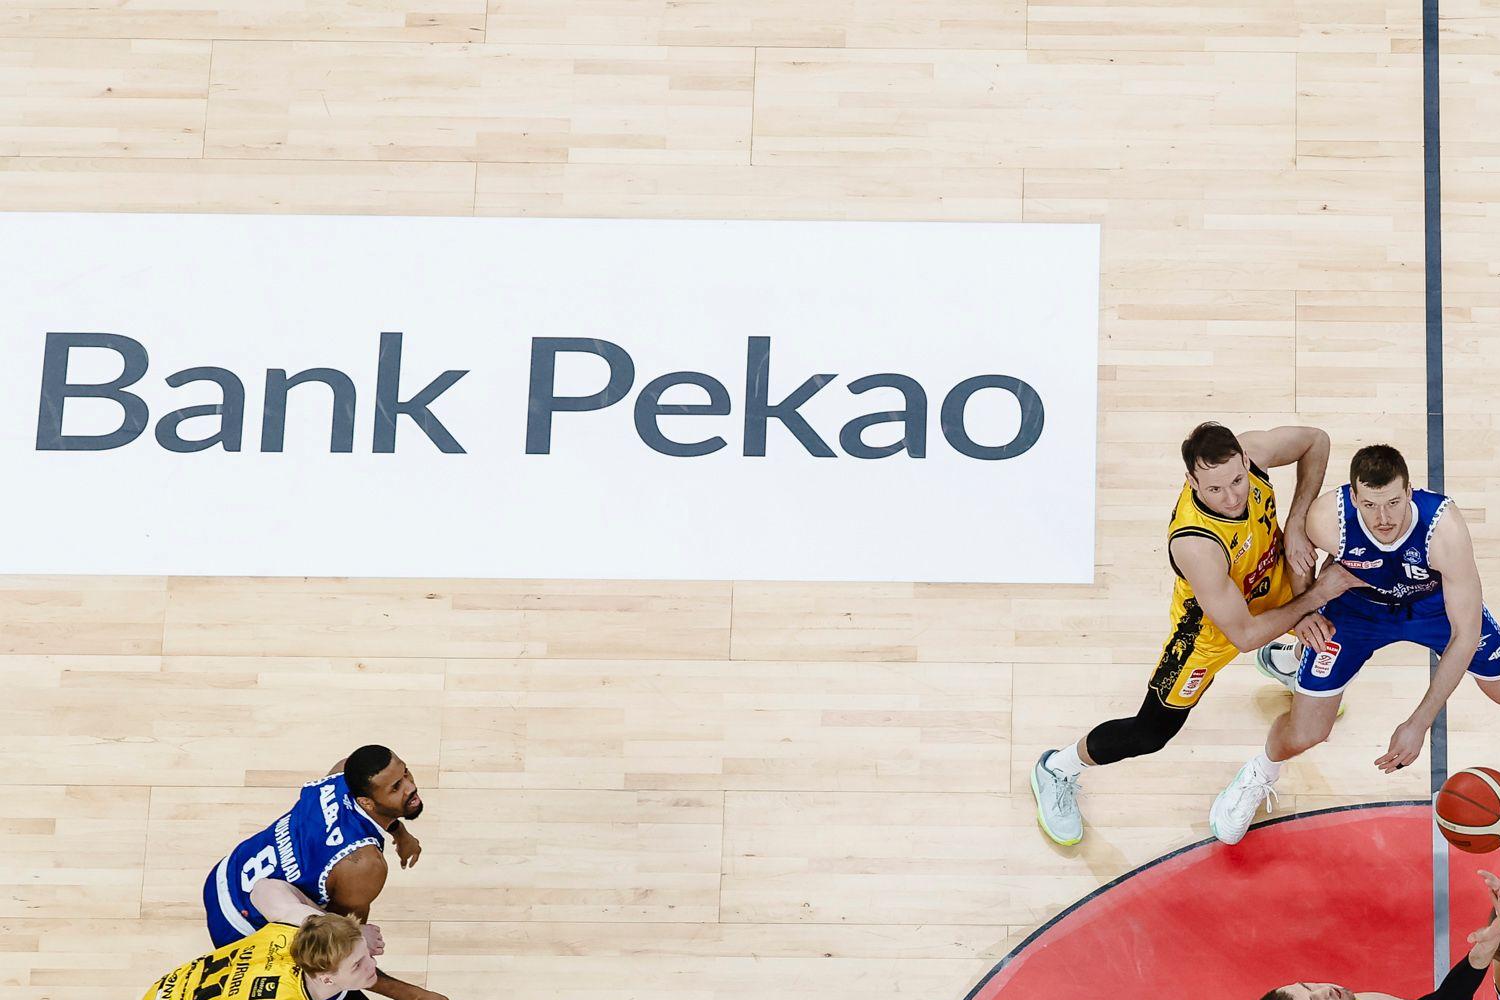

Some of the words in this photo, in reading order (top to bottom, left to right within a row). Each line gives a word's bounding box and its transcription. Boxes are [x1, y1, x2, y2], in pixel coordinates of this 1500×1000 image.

[36, 332, 467, 453] Bank
[526, 336, 1044, 460] Pekao
[1402, 562, 1430, 580] 15
[320, 784, 340, 834] ALBA
[241, 844, 278, 894] 8
[274, 813, 302, 884] MUHAMMAD
